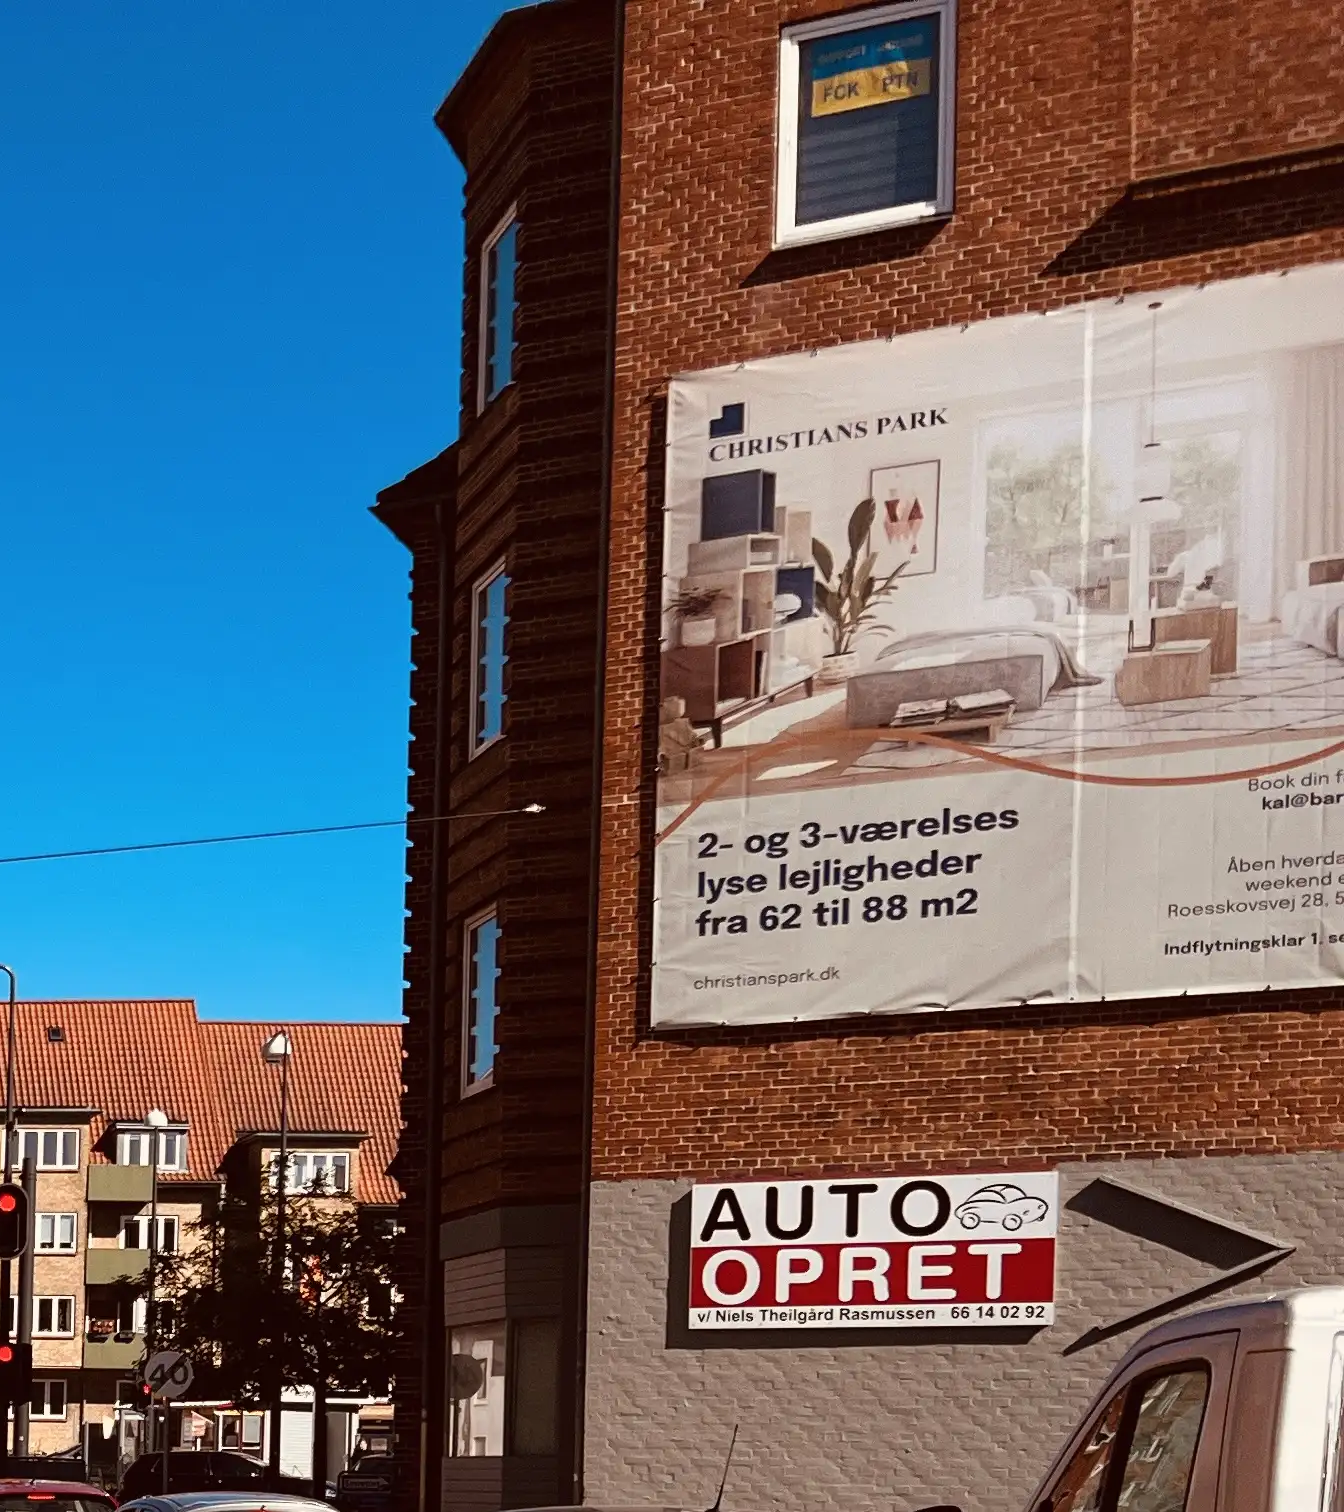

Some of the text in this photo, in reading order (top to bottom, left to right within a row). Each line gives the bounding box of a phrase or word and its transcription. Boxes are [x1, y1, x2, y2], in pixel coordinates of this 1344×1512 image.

[709, 407, 949, 462] CHRISTIANS PARK
[1249, 774, 1296, 792] Book
[1300, 772, 1330, 787] din
[1262, 792, 1344, 811] kal@bar
[698, 807, 1020, 859] 2- og 3-værelses
[1228, 850, 1344, 874] Åben hverda
[698, 849, 983, 904] lyse lejligheder
[1246, 872, 1333, 892] weekend
[695, 888, 979, 937] fra 62 til 88 m2
[1168, 894, 1297, 919] Roesskovsvej
[1164, 934, 1306, 956] Indflytningsklar
[1328, 933, 1344, 943] se
[693, 966, 841, 991] christianspark.dk
[700, 1180, 952, 1242] AUTO
[701, 1243, 1023, 1306] OPRET
[697, 1305, 1046, 1326] v/ Niels Theilgård Rasmussen 66 14 02 92
[149, 1361, 189, 1387] 40
